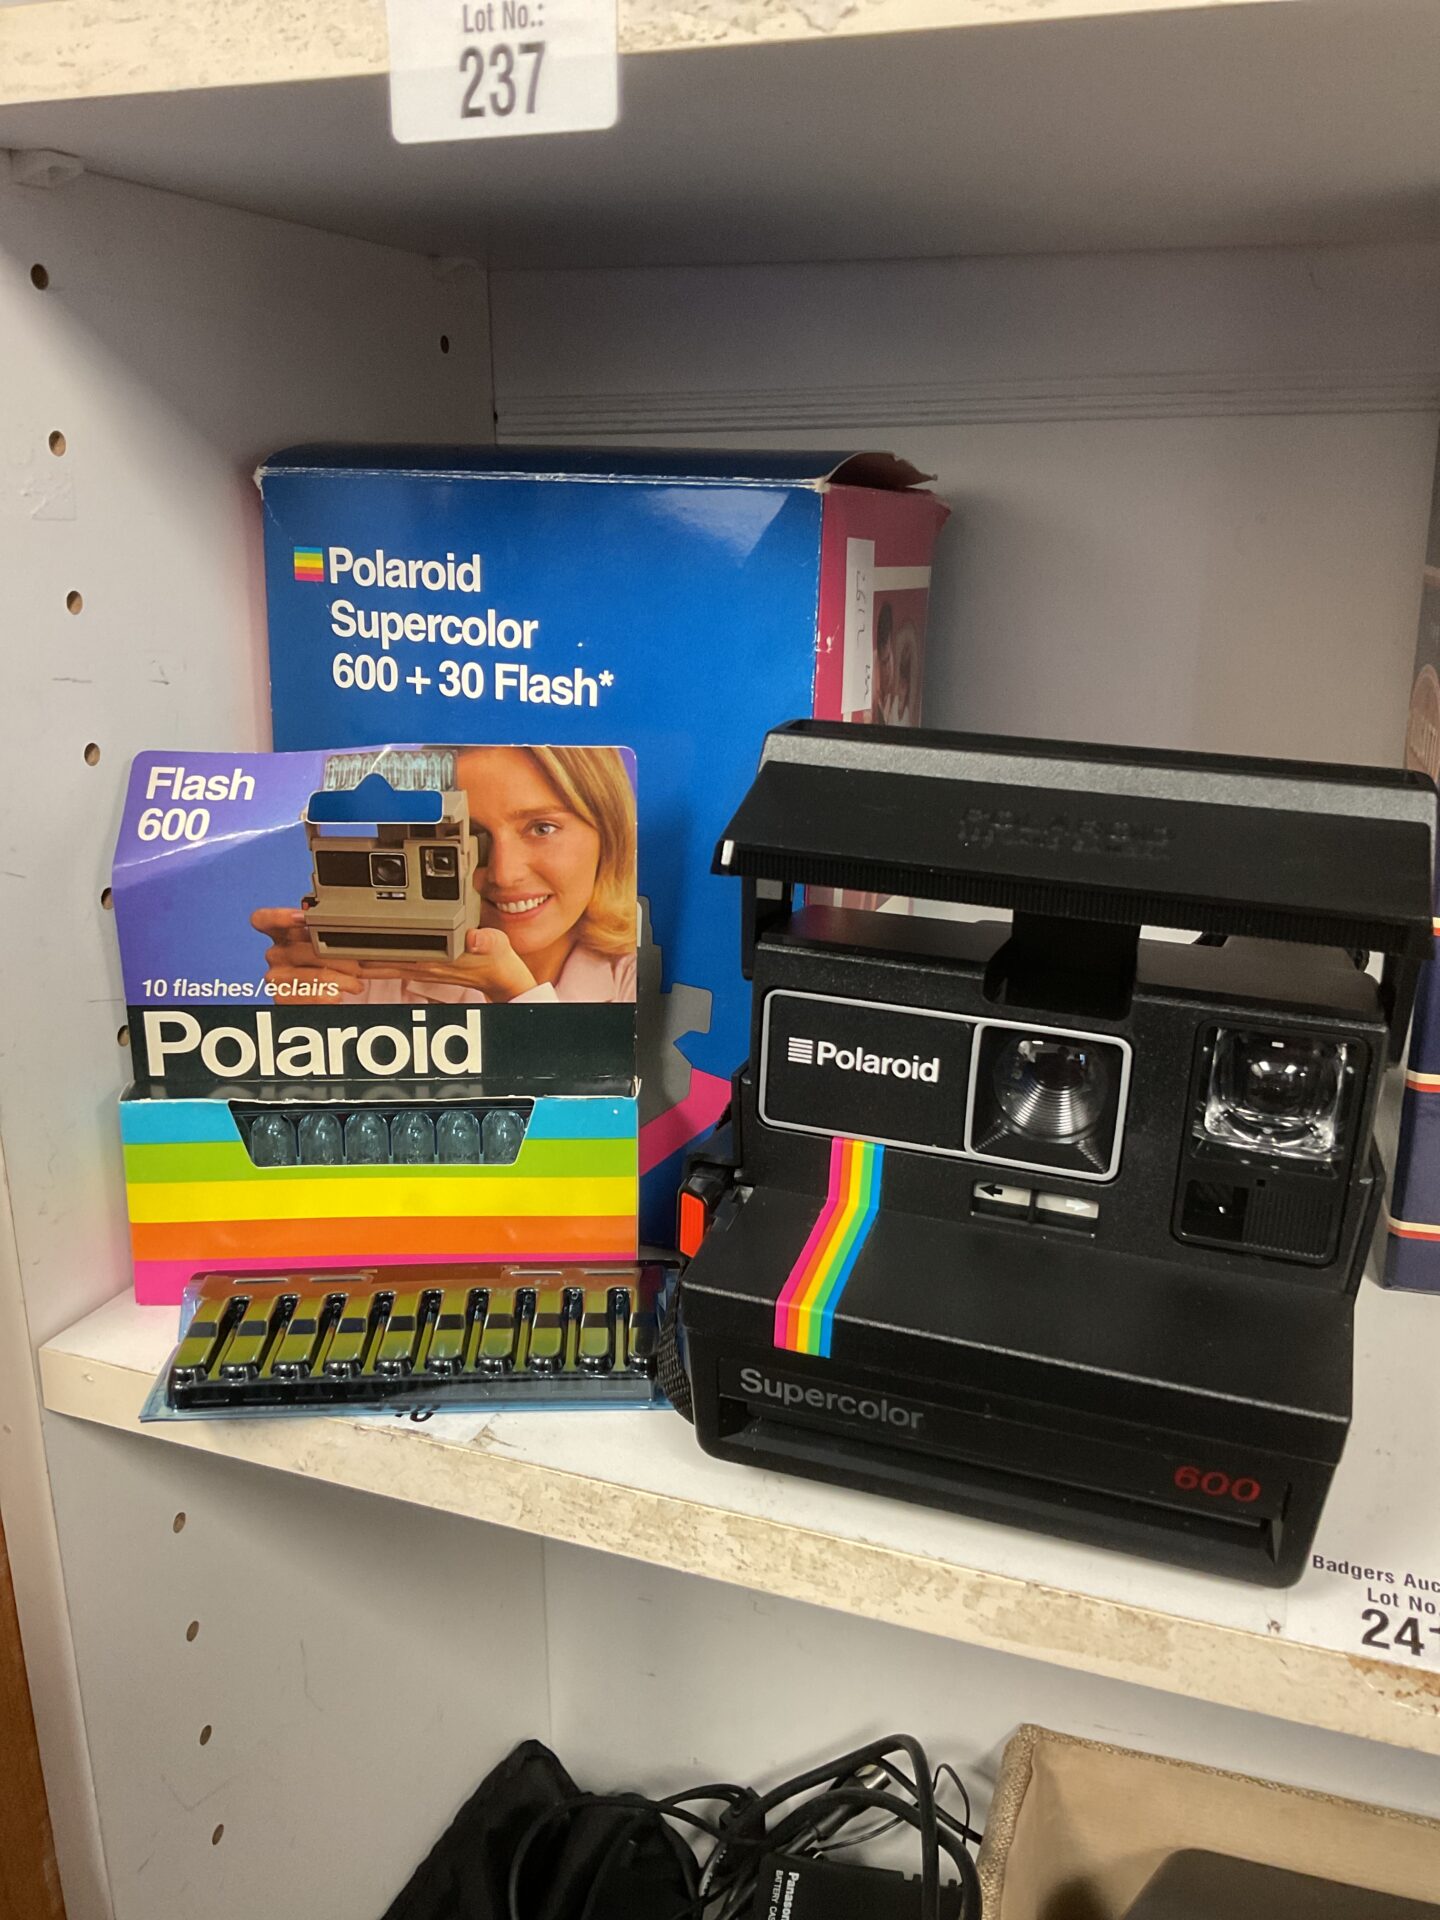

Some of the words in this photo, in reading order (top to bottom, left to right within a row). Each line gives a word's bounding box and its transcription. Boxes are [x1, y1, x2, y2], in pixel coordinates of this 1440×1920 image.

[462, 1, 495, 34] Lot
[502, 0, 545, 31] No.:
[458, 41, 546, 119] 237
[328, 546, 482, 593] Polaroid
[330, 599, 539, 650] Supercolor
[332, 652, 399, 693] 600
[405, 666, 431, 695] +
[438, 660, 484, 700] 30
[145, 766, 256, 801] Flash
[137, 807, 211, 842] 600
[141, 979, 168, 998] 10
[172, 978, 340, 999] flashes/éclairs
[142, 1008, 484, 1079] Polaroid
[816, 1041, 940, 1083] Polaroid
[739, 1367, 925, 1429] Supercolor
[1174, 1465, 1261, 1502] 600
[1312, 1554, 1396, 1584] Badgers
[1366, 1587, 1400, 1608] Lot
[1361, 1608, 1440, 1657] 24
[771, 1869, 784, 1904] BATTERY
